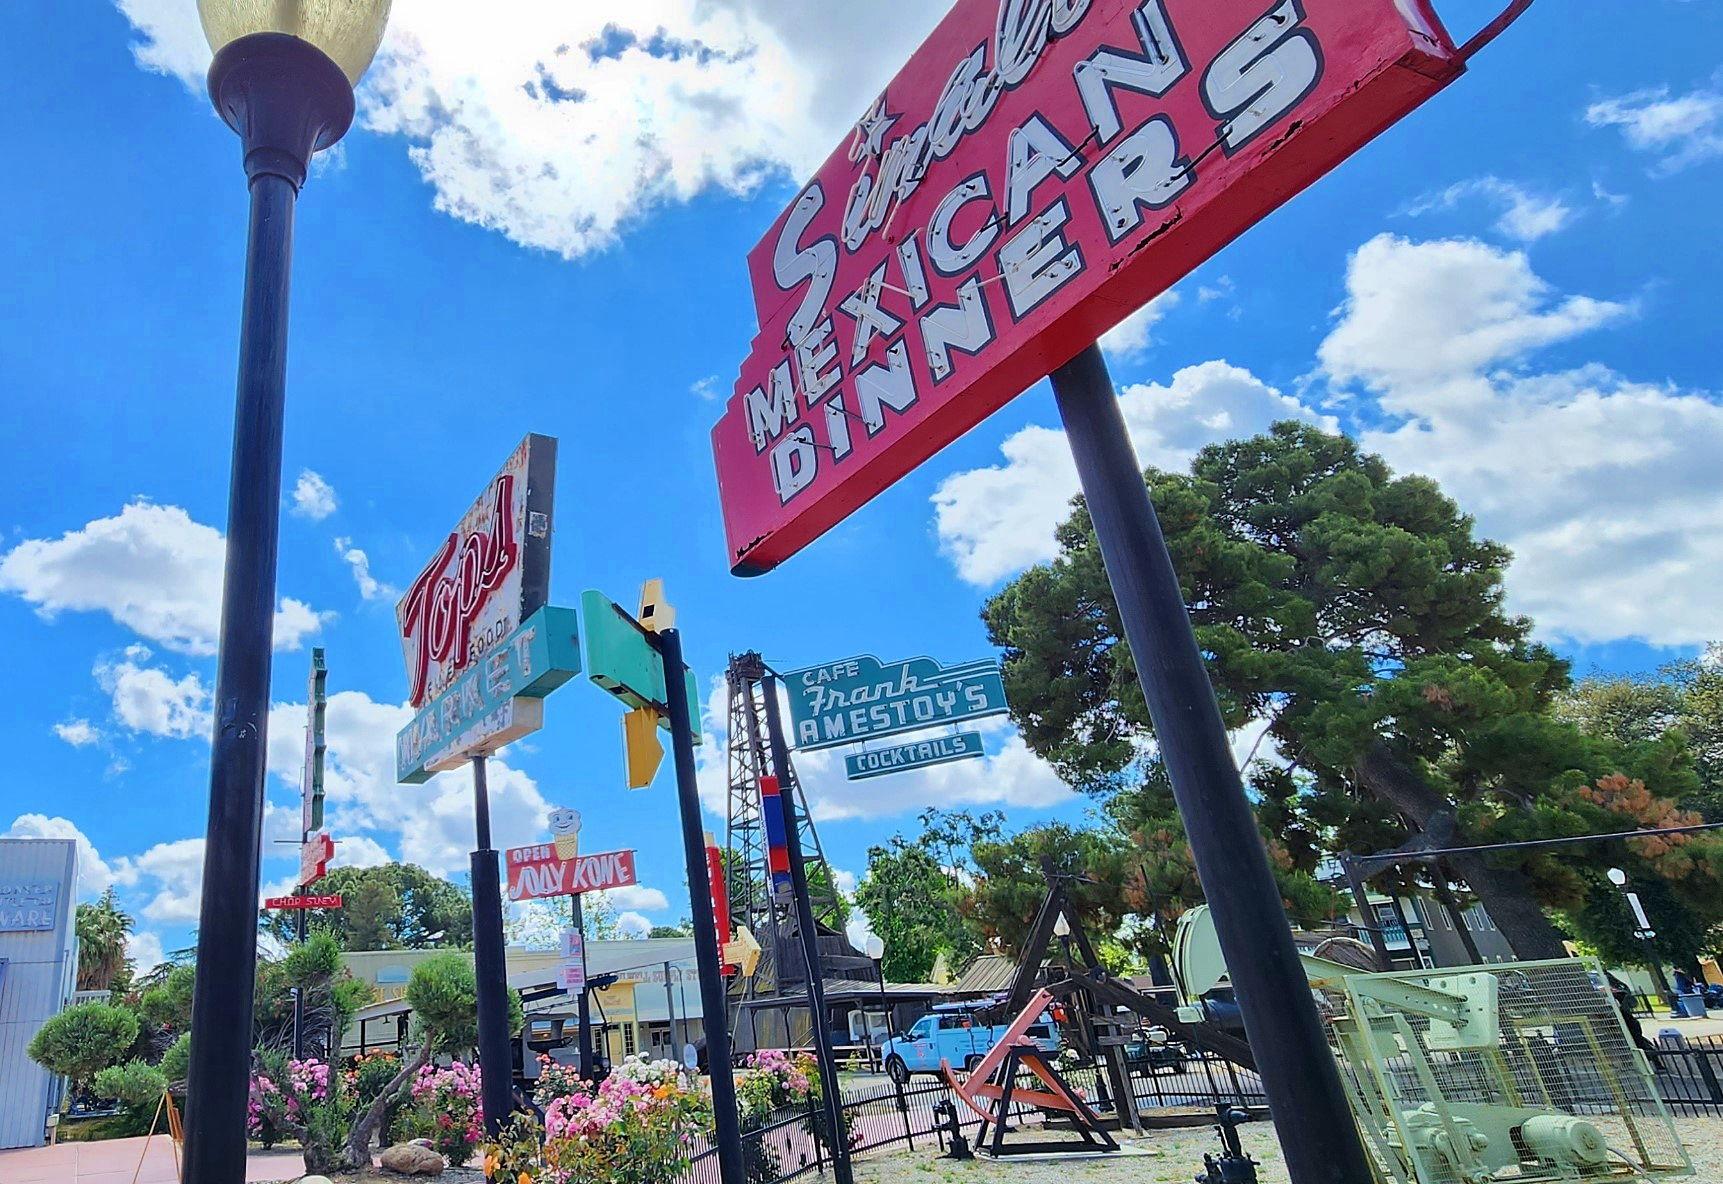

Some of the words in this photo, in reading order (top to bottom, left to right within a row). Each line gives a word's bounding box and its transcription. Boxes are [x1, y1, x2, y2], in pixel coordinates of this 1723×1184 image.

[743, 0, 1191, 454] MEXICAN
[769, 0, 1326, 503] DINNERS
[404, 474, 518, 708] Tops
[398, 625, 537, 772] MARKET
[802, 661, 860, 687] CAFE
[802, 664, 940, 717] Frank
[800, 681, 988, 745] AMESTOY'S
[857, 737, 967, 771] COCKTAILS
[513, 845, 551, 863] OPEN
[572, 853, 632, 889] KONE
[272, 896, 301, 907] CHOP
[306, 896, 337, 906] SUEY
